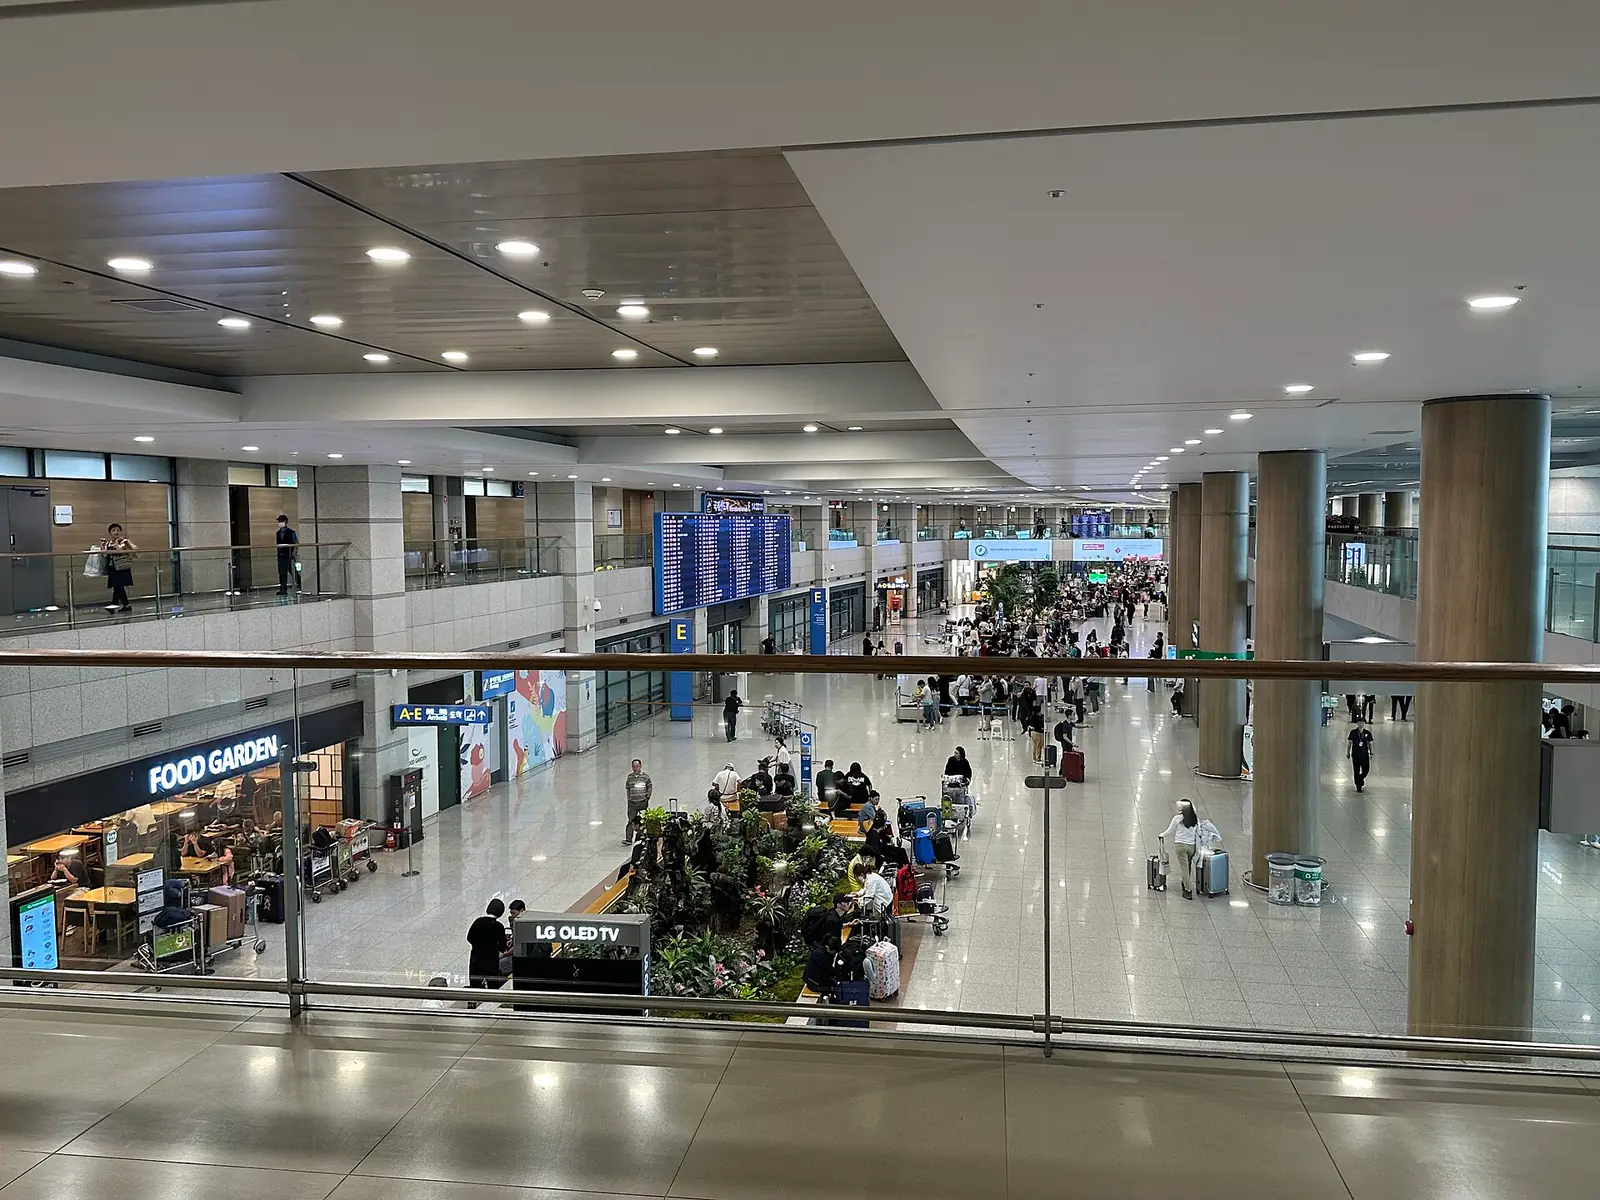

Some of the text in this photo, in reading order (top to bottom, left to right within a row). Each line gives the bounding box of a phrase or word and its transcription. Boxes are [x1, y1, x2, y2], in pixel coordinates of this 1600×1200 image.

[814, 591, 822, 603] E
[676, 624, 688, 640] E
[399, 707, 422, 720] A-E
[149, 734, 279, 794] FOOD GARDEN
[536, 925, 620, 942] LG OLED TV
